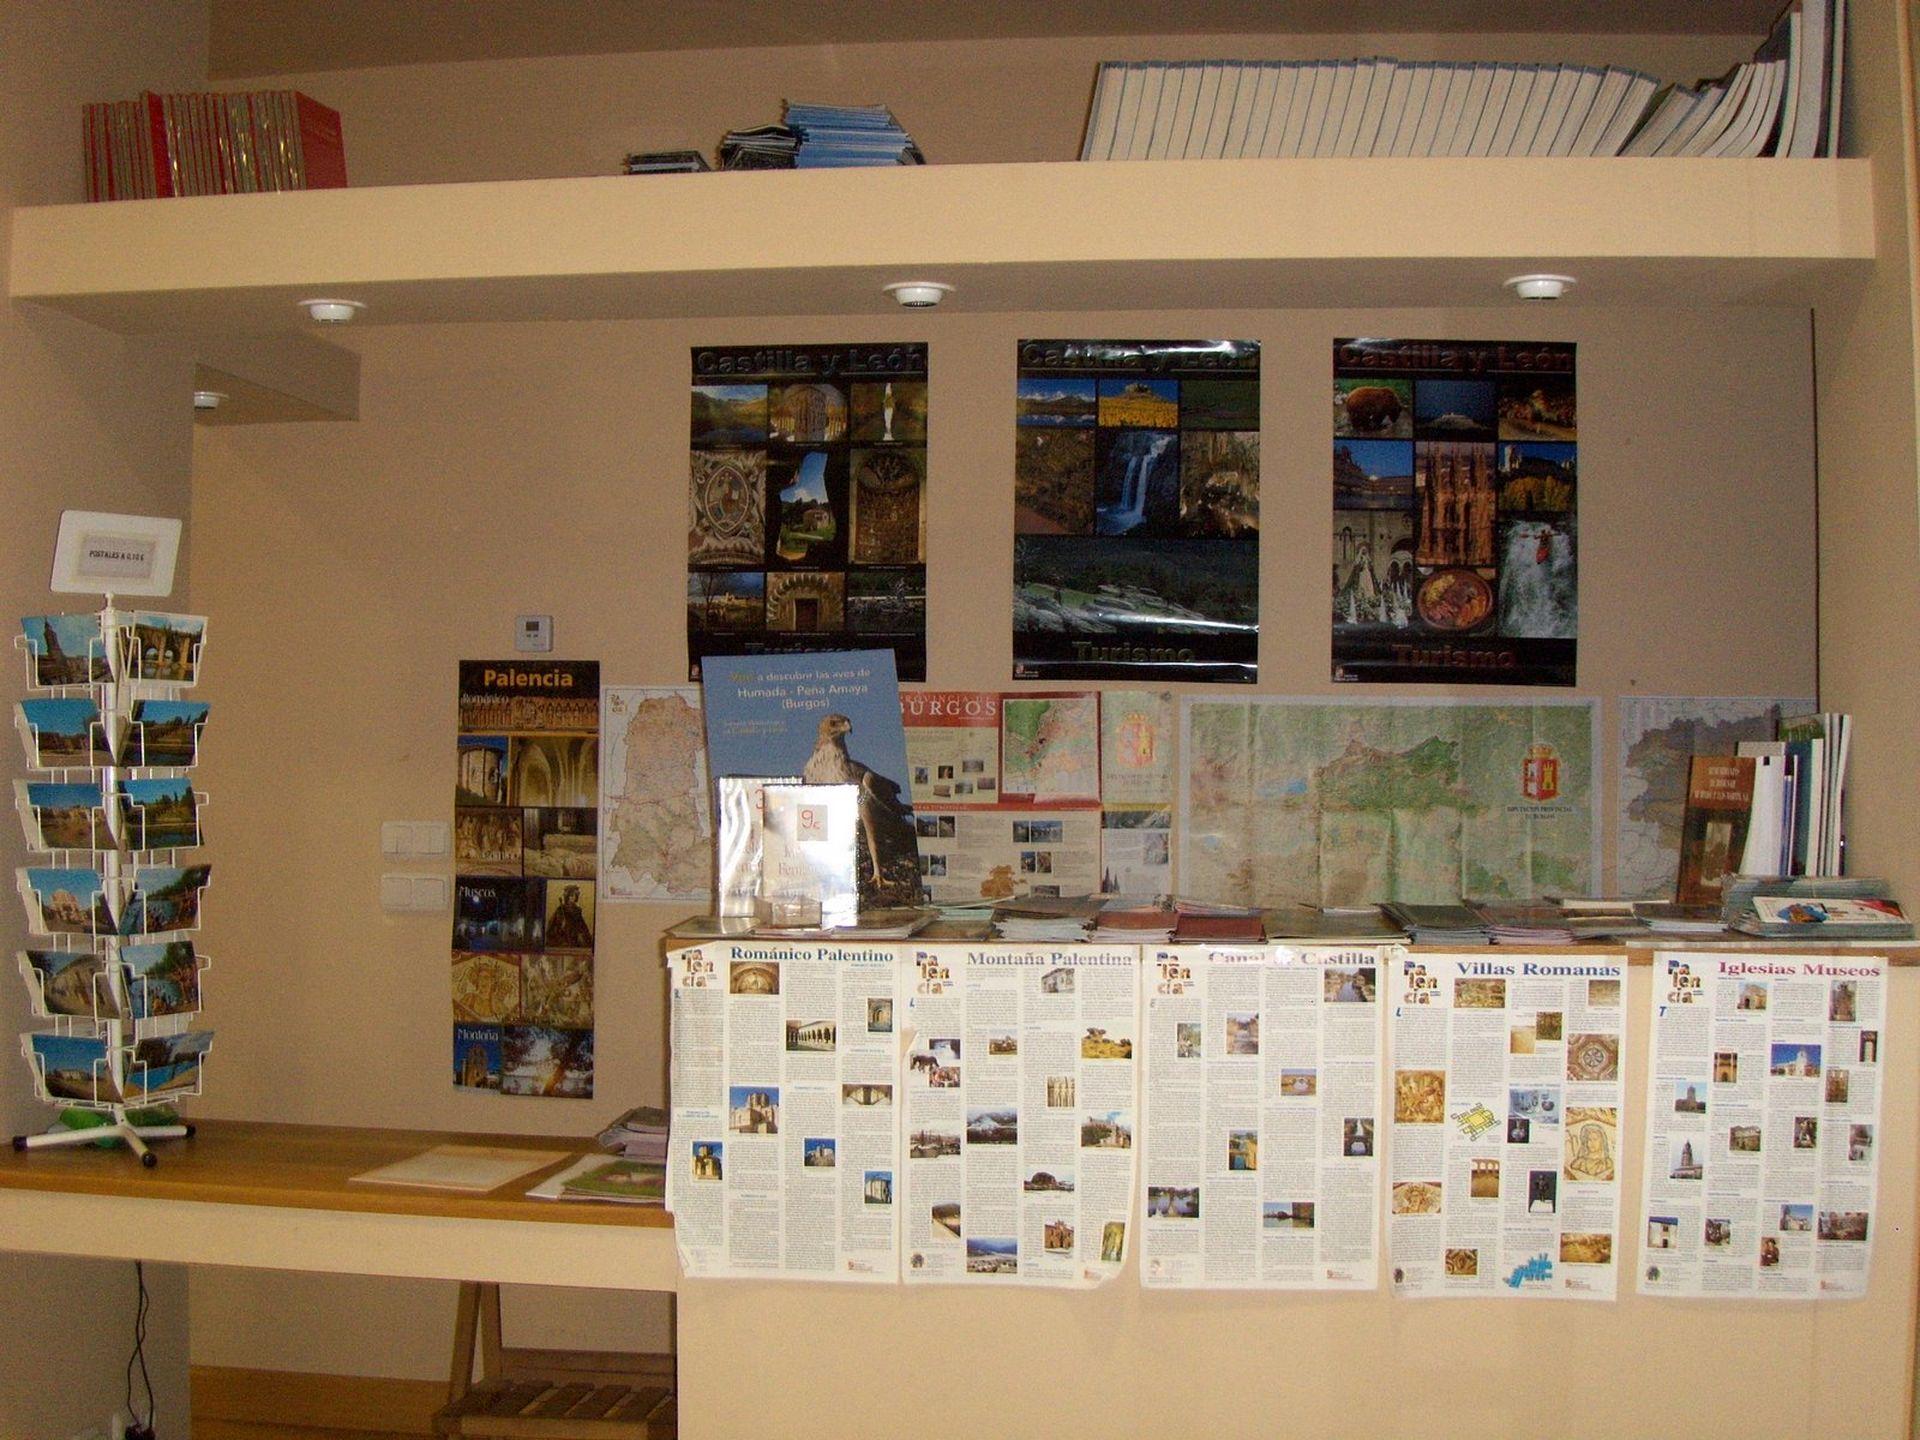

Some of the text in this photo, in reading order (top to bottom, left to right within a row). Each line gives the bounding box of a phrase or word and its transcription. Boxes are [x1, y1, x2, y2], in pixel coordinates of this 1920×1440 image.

[697, 348, 922, 376] Castilla y León
[1072, 641, 1195, 662] Turismo
[1391, 645, 1517, 667] Turismo
[484, 668, 573, 687] Palencia
[737, 687, 787, 698] Humada
[828, 683, 869, 696] Amaya
[782, 698, 831, 711] (Burgos)
[730, 946, 894, 962] Románico Palentino
[967, 951, 1132, 966] Montaña Palentina
[1456, 961, 1621, 976] Villas Romanas
[1718, 960, 1881, 977] Iglesias Museos
